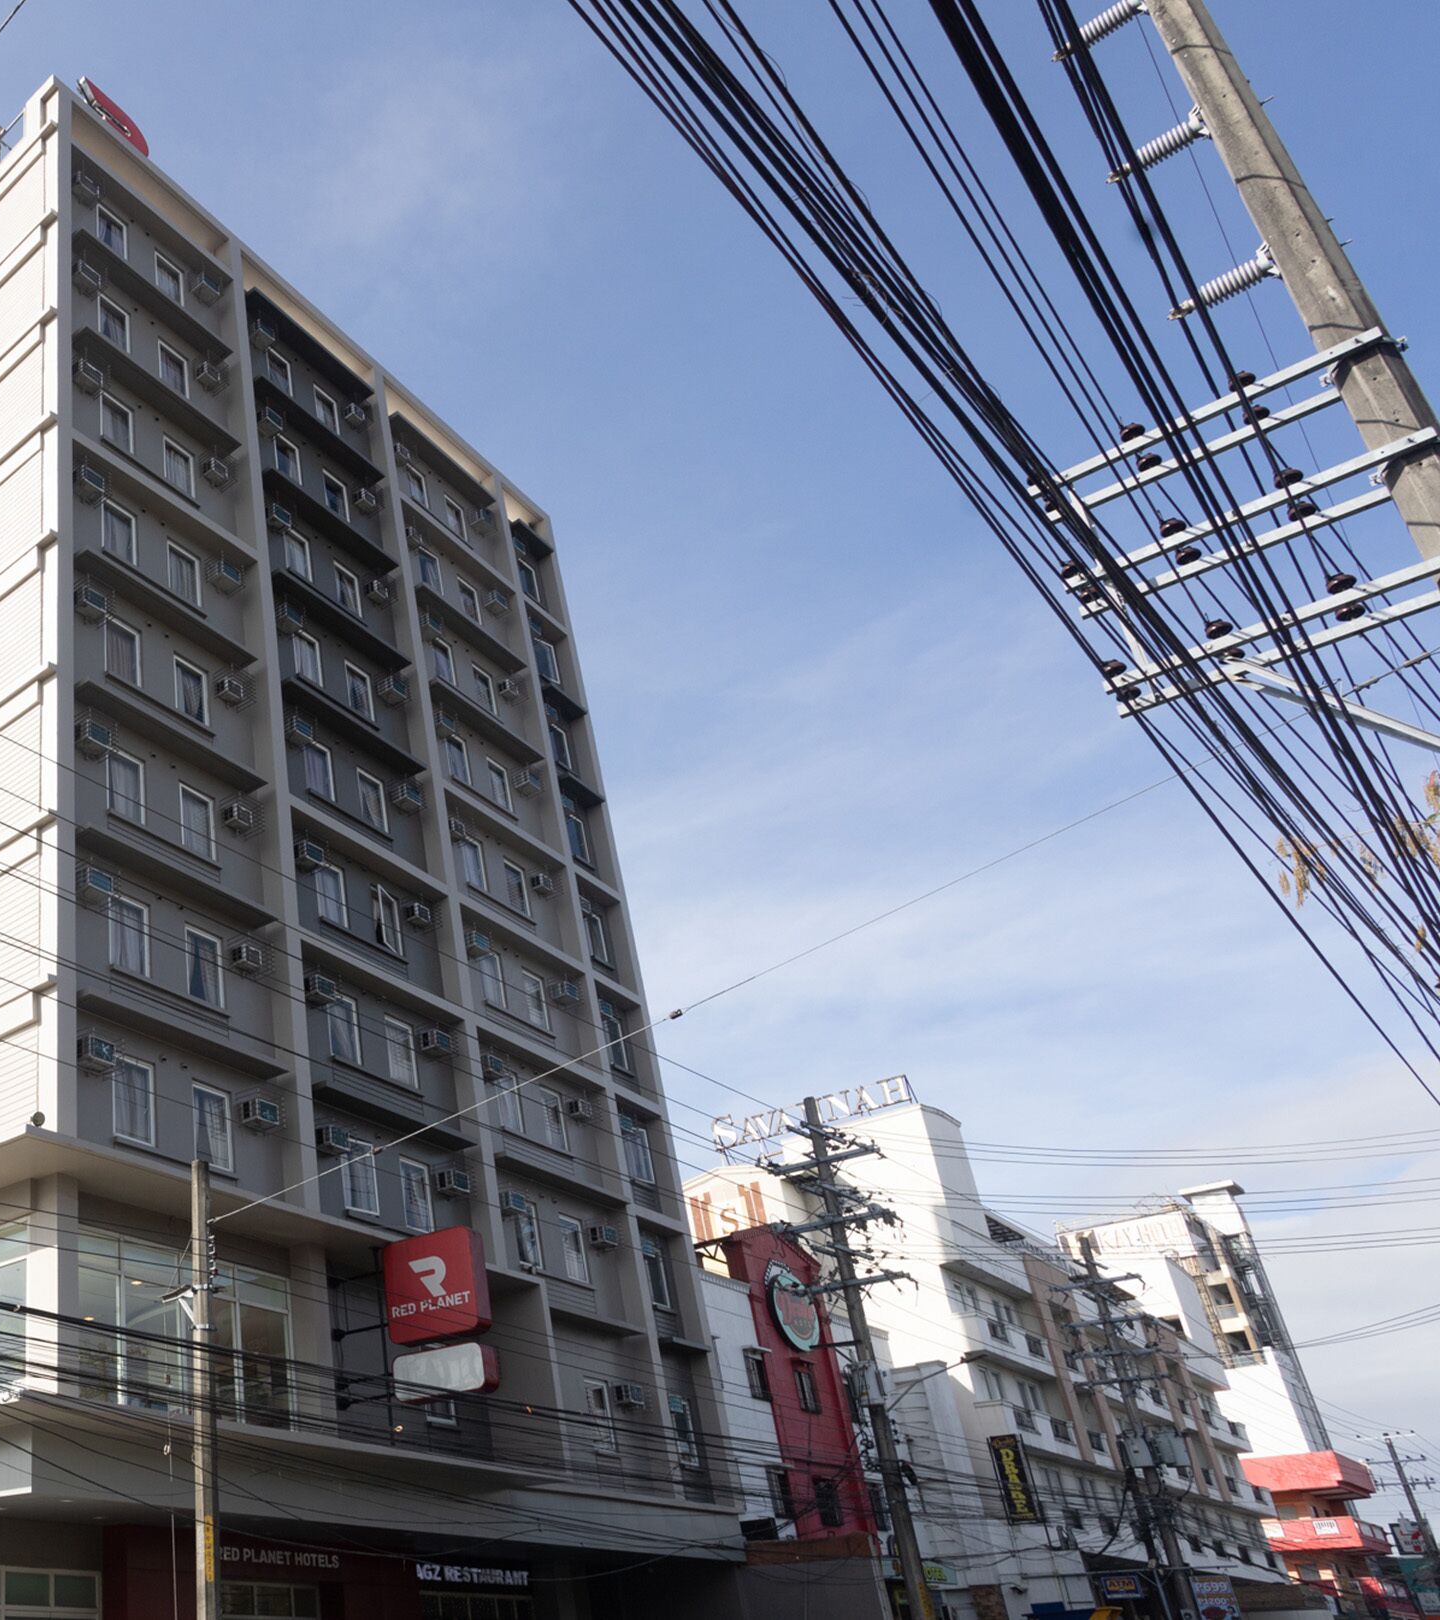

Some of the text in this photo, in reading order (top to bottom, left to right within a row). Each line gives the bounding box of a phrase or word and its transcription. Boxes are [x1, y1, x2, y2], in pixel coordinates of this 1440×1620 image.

[391, 1290, 471, 1318] RED PLANET
[243, 1548, 293, 1566] PLANET
[295, 1551, 340, 1569] HOTELS
[443, 1566, 529, 1586] RESTAURANT
